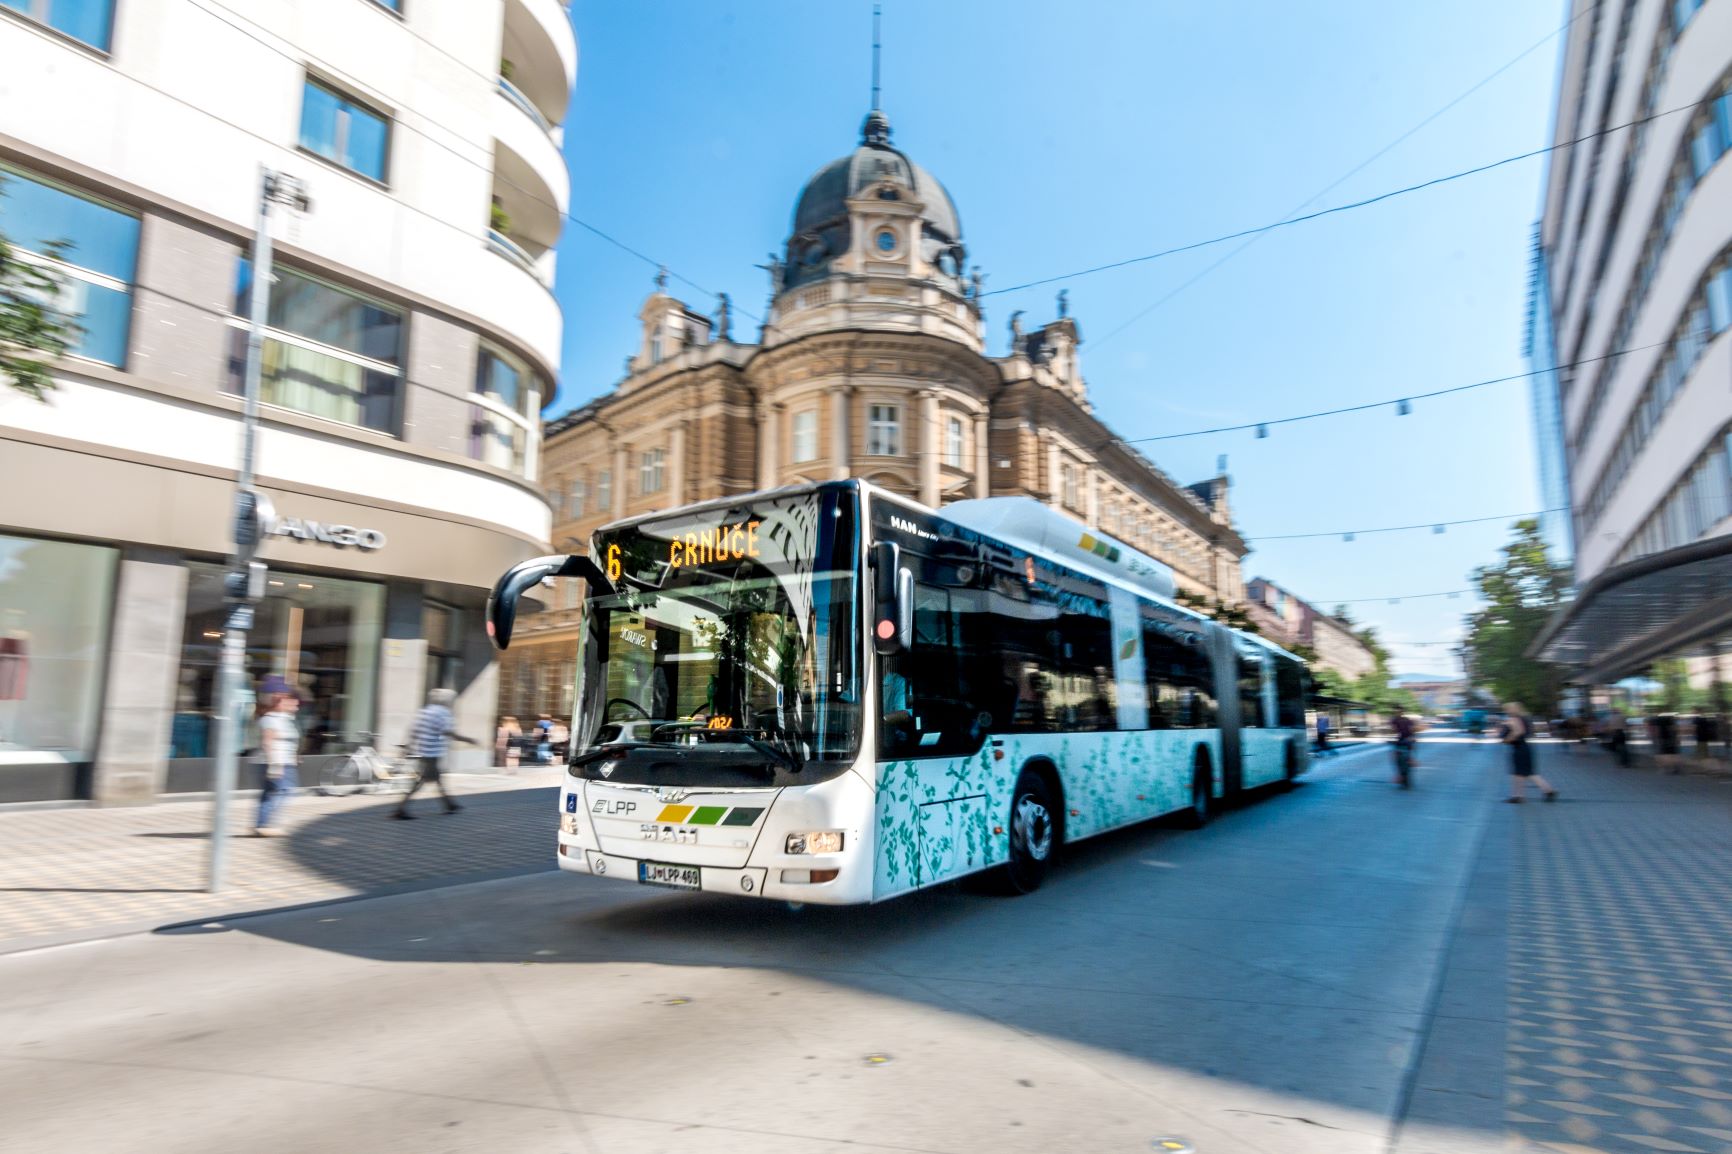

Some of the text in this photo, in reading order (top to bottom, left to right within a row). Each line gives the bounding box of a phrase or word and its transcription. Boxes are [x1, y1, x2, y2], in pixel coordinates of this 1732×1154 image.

[890, 515, 917, 535] MAN
[607, 521, 760, 580] 6 ČRNUČE
[606, 800, 637, 815] LPP
[640, 824, 699, 845] MAN
[646, 865, 657, 880] LJ
